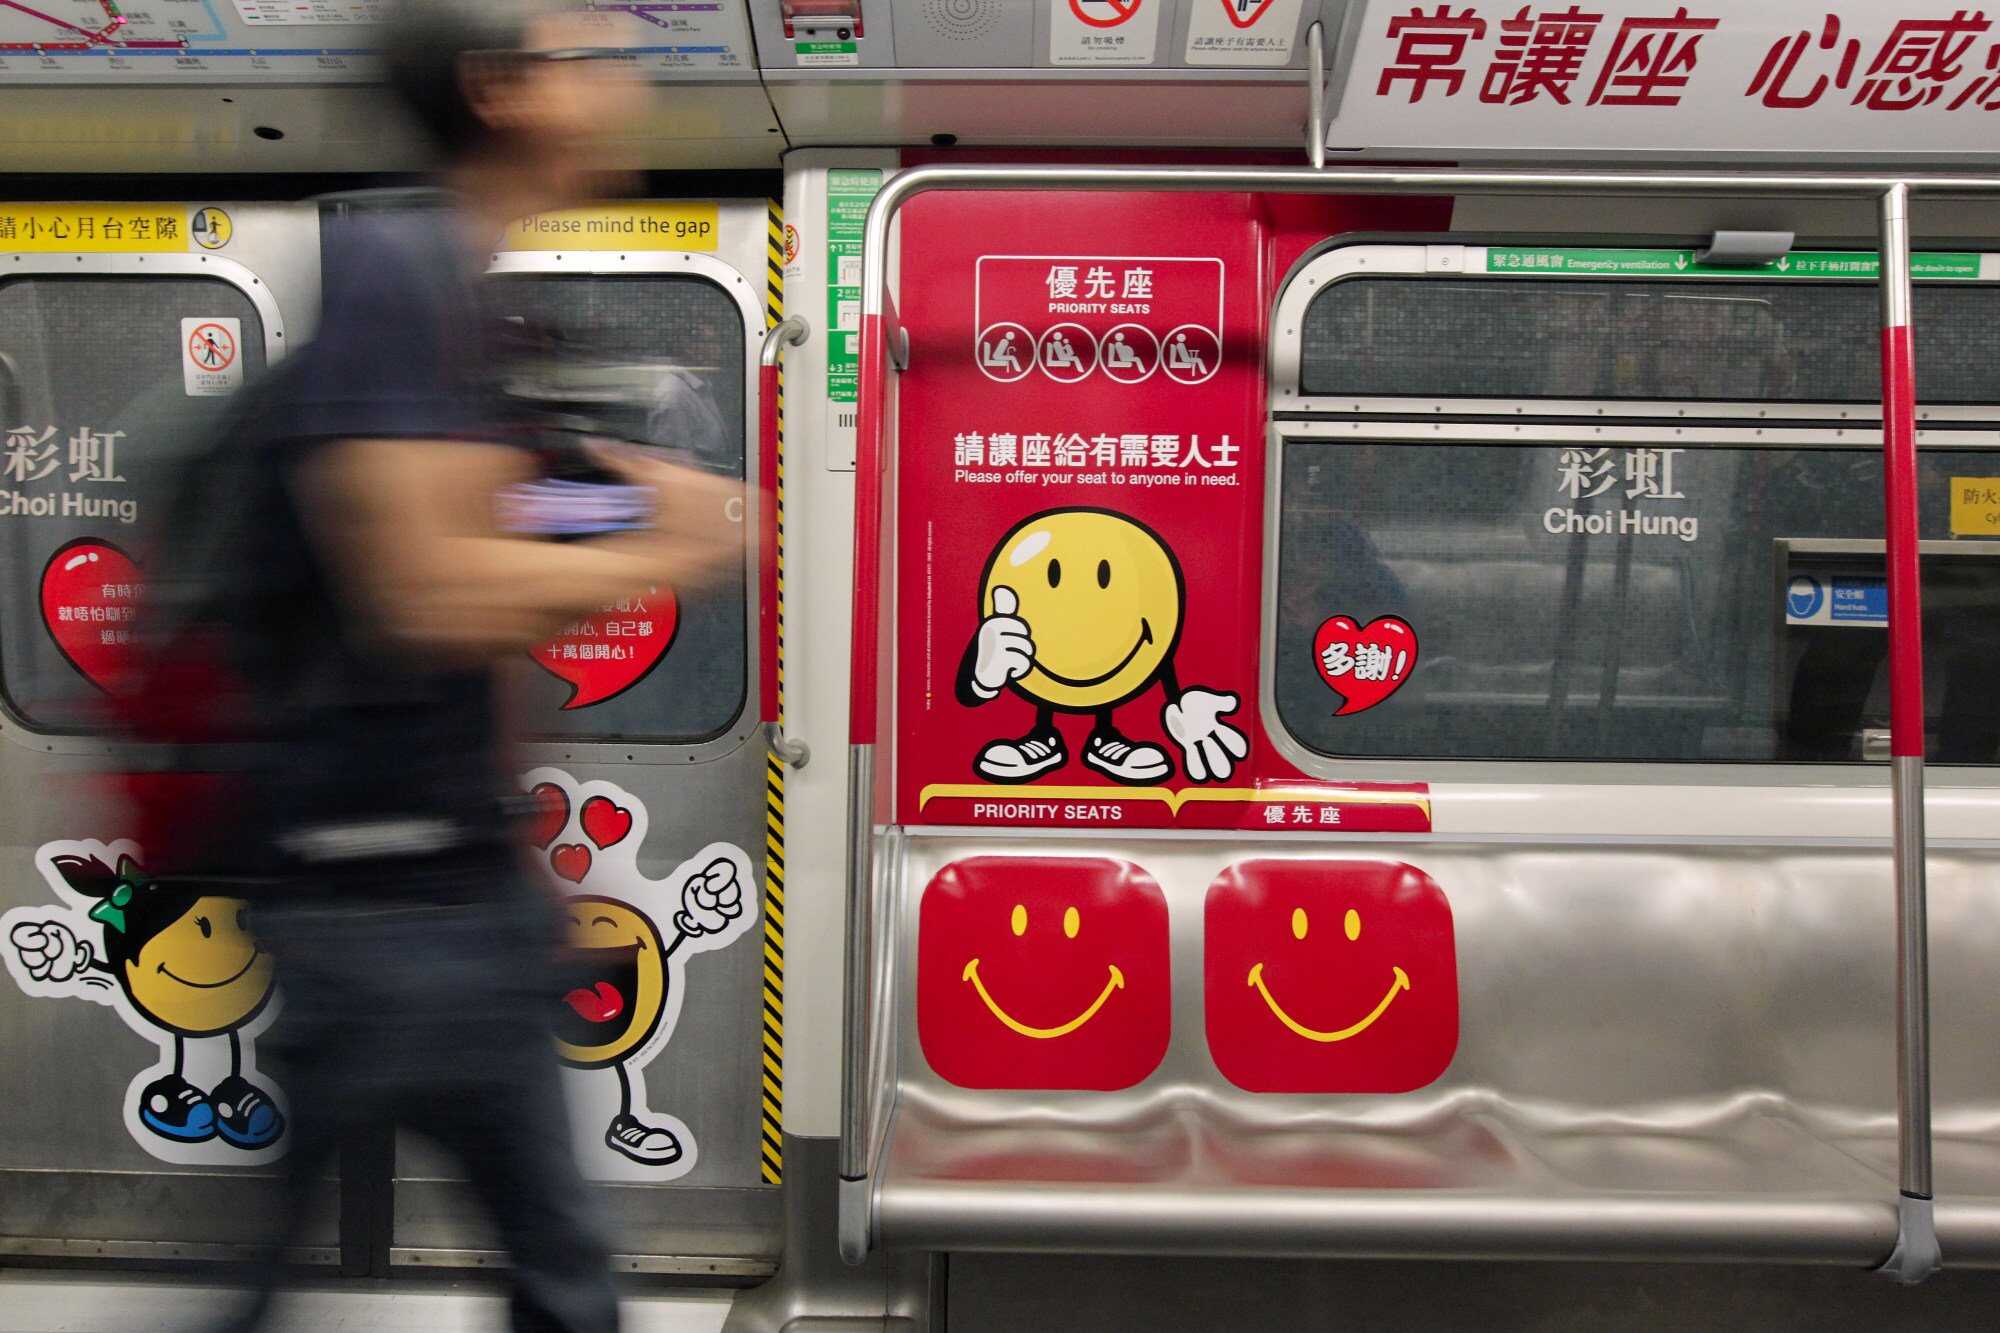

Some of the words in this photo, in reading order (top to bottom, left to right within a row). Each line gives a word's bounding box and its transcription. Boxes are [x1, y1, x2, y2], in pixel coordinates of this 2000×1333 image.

[1376, 4, 1720, 107] 常讓座
[0, 216, 179, 240] 請小心月台空隙
[522, 215, 581, 233] Please
[586, 216, 634, 233] mind
[640, 216, 671, 234] the
[675, 219, 711, 238] gap
[1567, 258, 1619, 270] Emergency
[1045, 265, 1153, 299] 優先座
[1048, 303, 1107, 314] PRIORITY
[1110, 303, 1150, 314] SEATS
[4, 425, 127, 483] 彩虹
[954, 431, 1240, 468] 請讓座給有需要人士
[955, 469, 1001, 483] Please
[1005, 469, 1038, 484] offer
[1042, 473, 1074, 486] your
[1077, 472, 1106, 485] seat
[1111, 472, 1125, 485] to
[1129, 475, 1181, 488] anyone
[1185, 472, 1197, 486] in
[1201, 472, 1240, 486] need.
[1557, 448, 1685, 500] 彩虹
[61, 492, 138, 524] Hung
[1963, 488, 2000, 504] 防火
[1543, 507, 1612, 534] Choi
[1620, 511, 1698, 541] Hung
[973, 803, 1058, 820] PRIORITY
[1064, 804, 1122, 821] SEATS
[1264, 805, 1341, 825] 優先座
